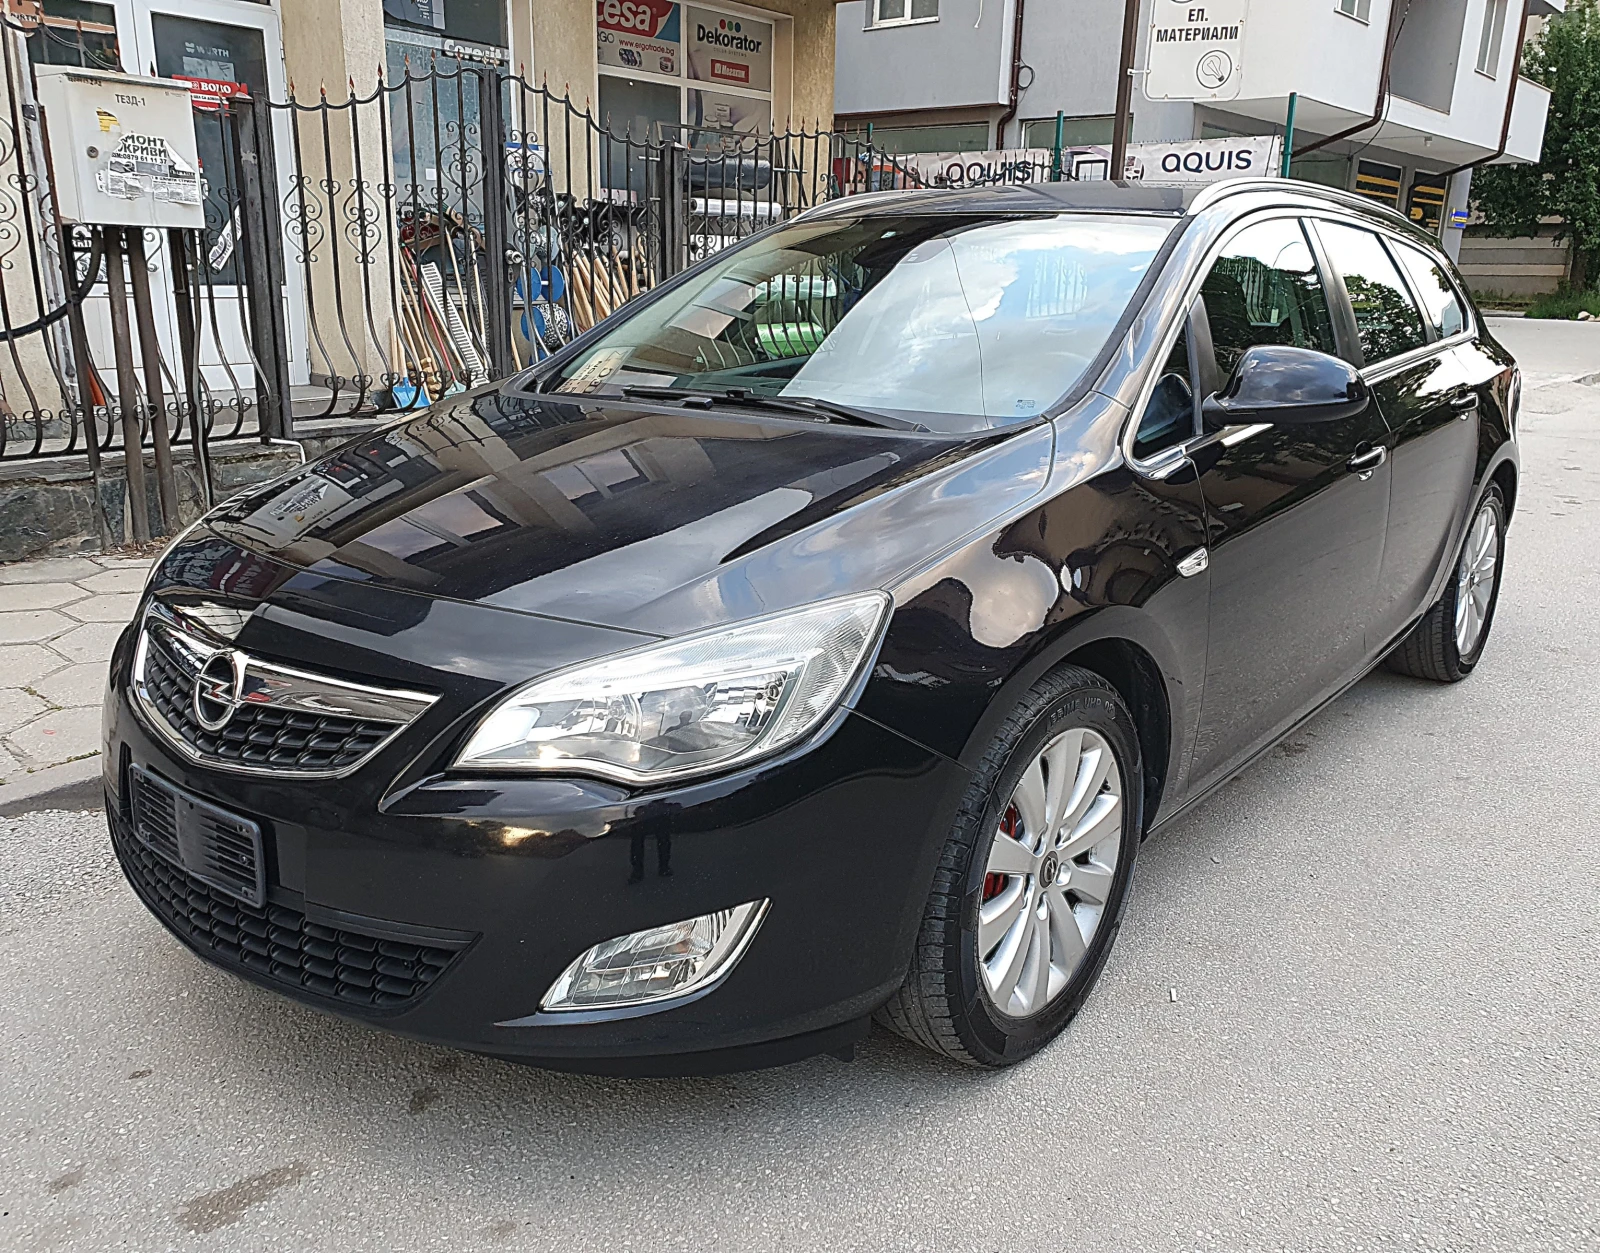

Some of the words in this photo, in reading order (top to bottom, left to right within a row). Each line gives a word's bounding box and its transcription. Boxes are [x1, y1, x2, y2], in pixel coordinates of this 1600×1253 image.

[1188, 8, 1209, 22] ЕЛ.
[696, 23, 762, 53] Dekorator
[1156, 26, 1239, 42] МАТЕРИАЛИ
[618, 39, 675, 56] www.ergotrade.bg
[115, 94, 146, 106] ТЕЗД-1
